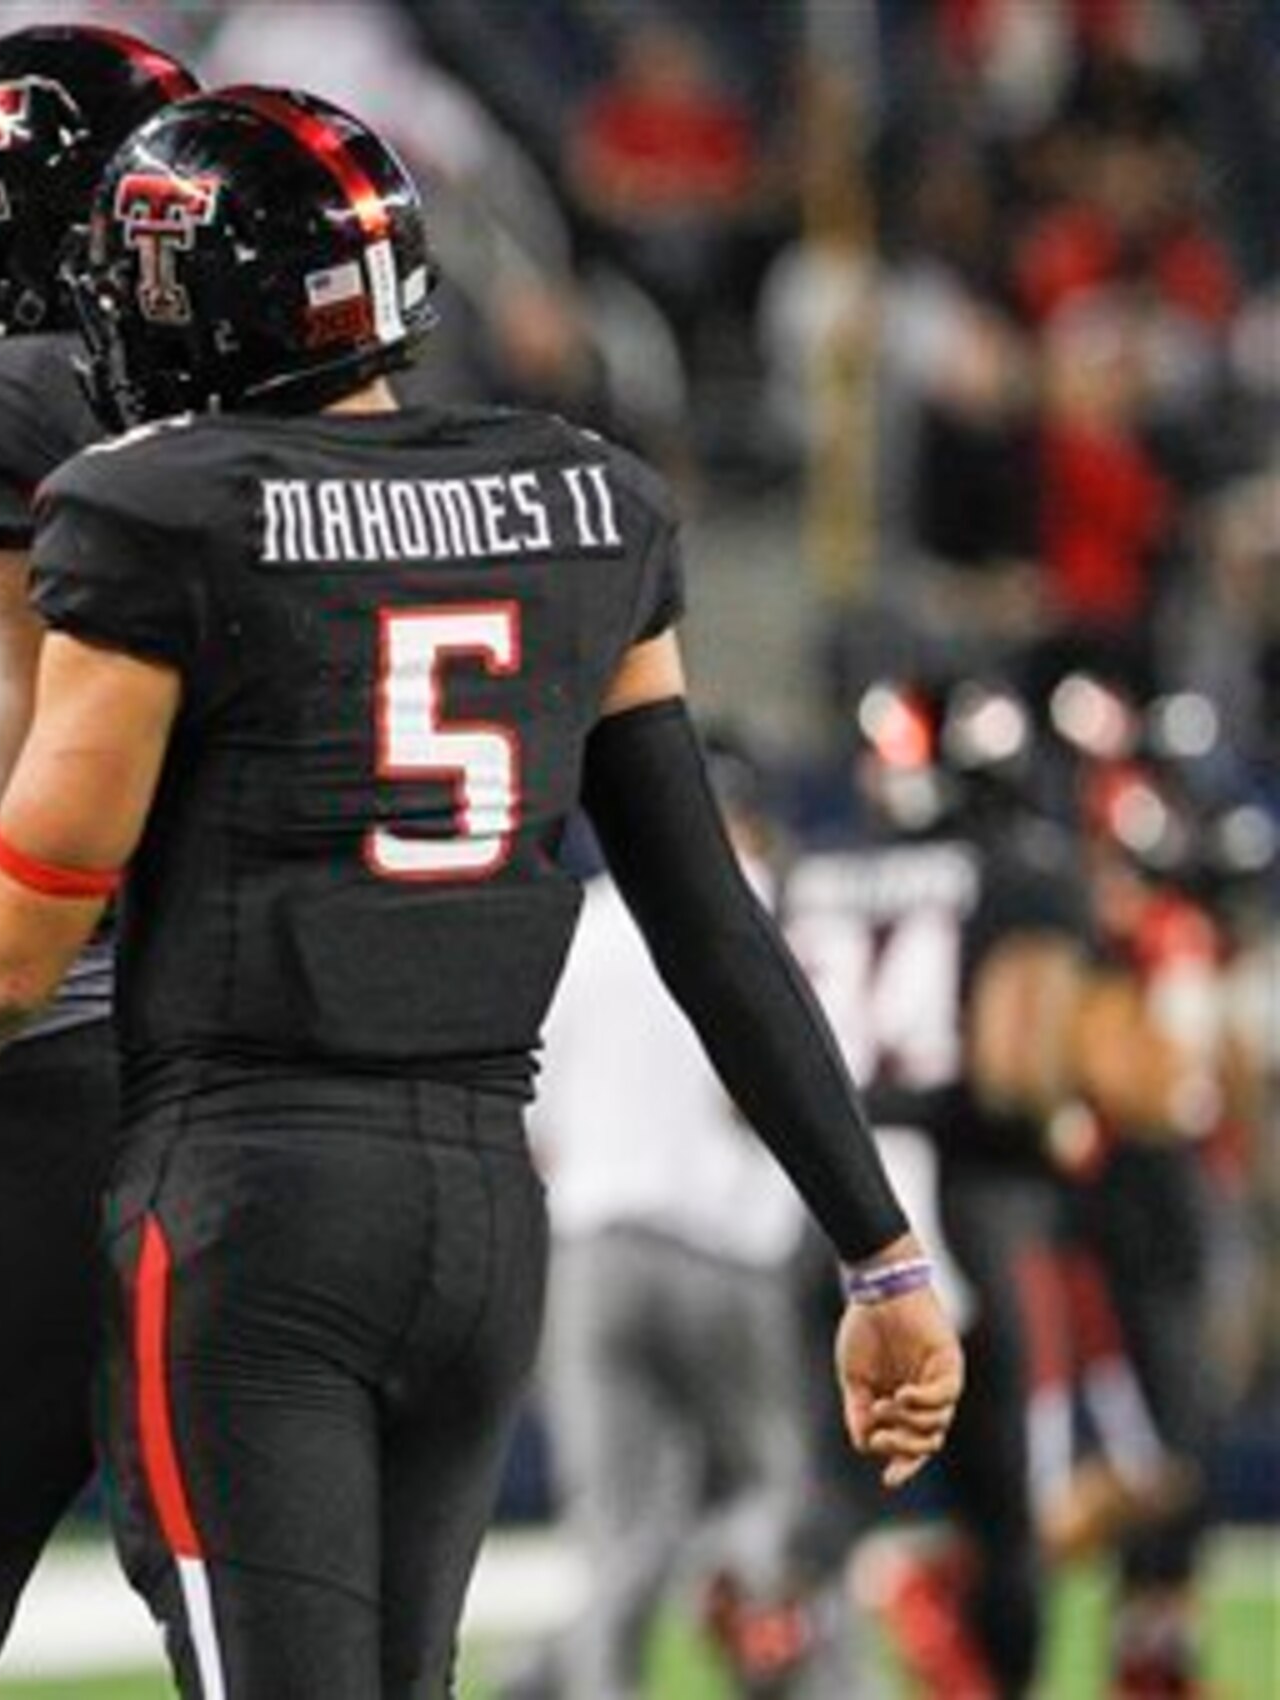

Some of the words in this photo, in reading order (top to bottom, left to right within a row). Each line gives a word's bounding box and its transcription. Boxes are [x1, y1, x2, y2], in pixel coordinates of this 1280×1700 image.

[259, 473, 551, 561] MAHOMES
[561, 464, 622, 546] II
[365, 600, 519, 884] 5
